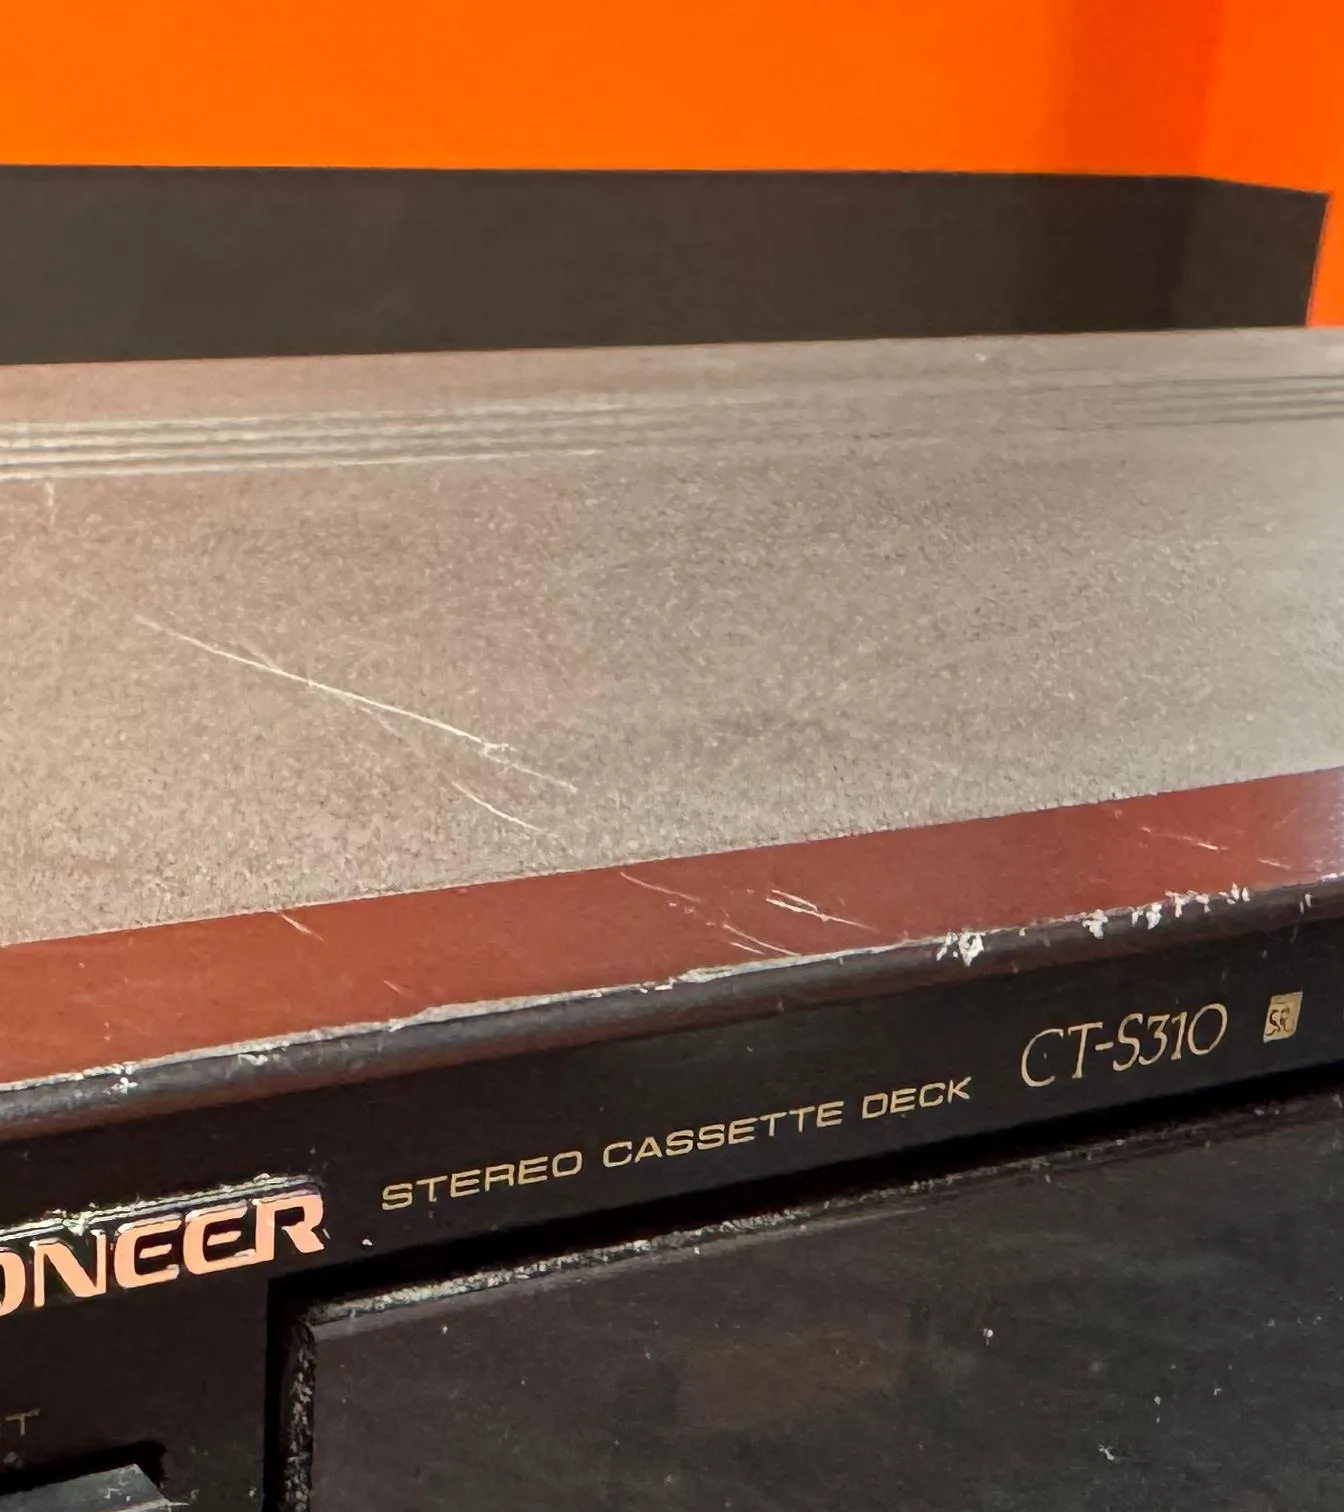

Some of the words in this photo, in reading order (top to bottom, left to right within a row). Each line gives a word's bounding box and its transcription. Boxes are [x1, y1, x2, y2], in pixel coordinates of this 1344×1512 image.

[381, 1150, 583, 1212] STEREO
[603, 1101, 844, 1169] CASSETTE
[861, 1076, 973, 1120] DECK
[1020, 1003, 1227, 1088] CT-S310
